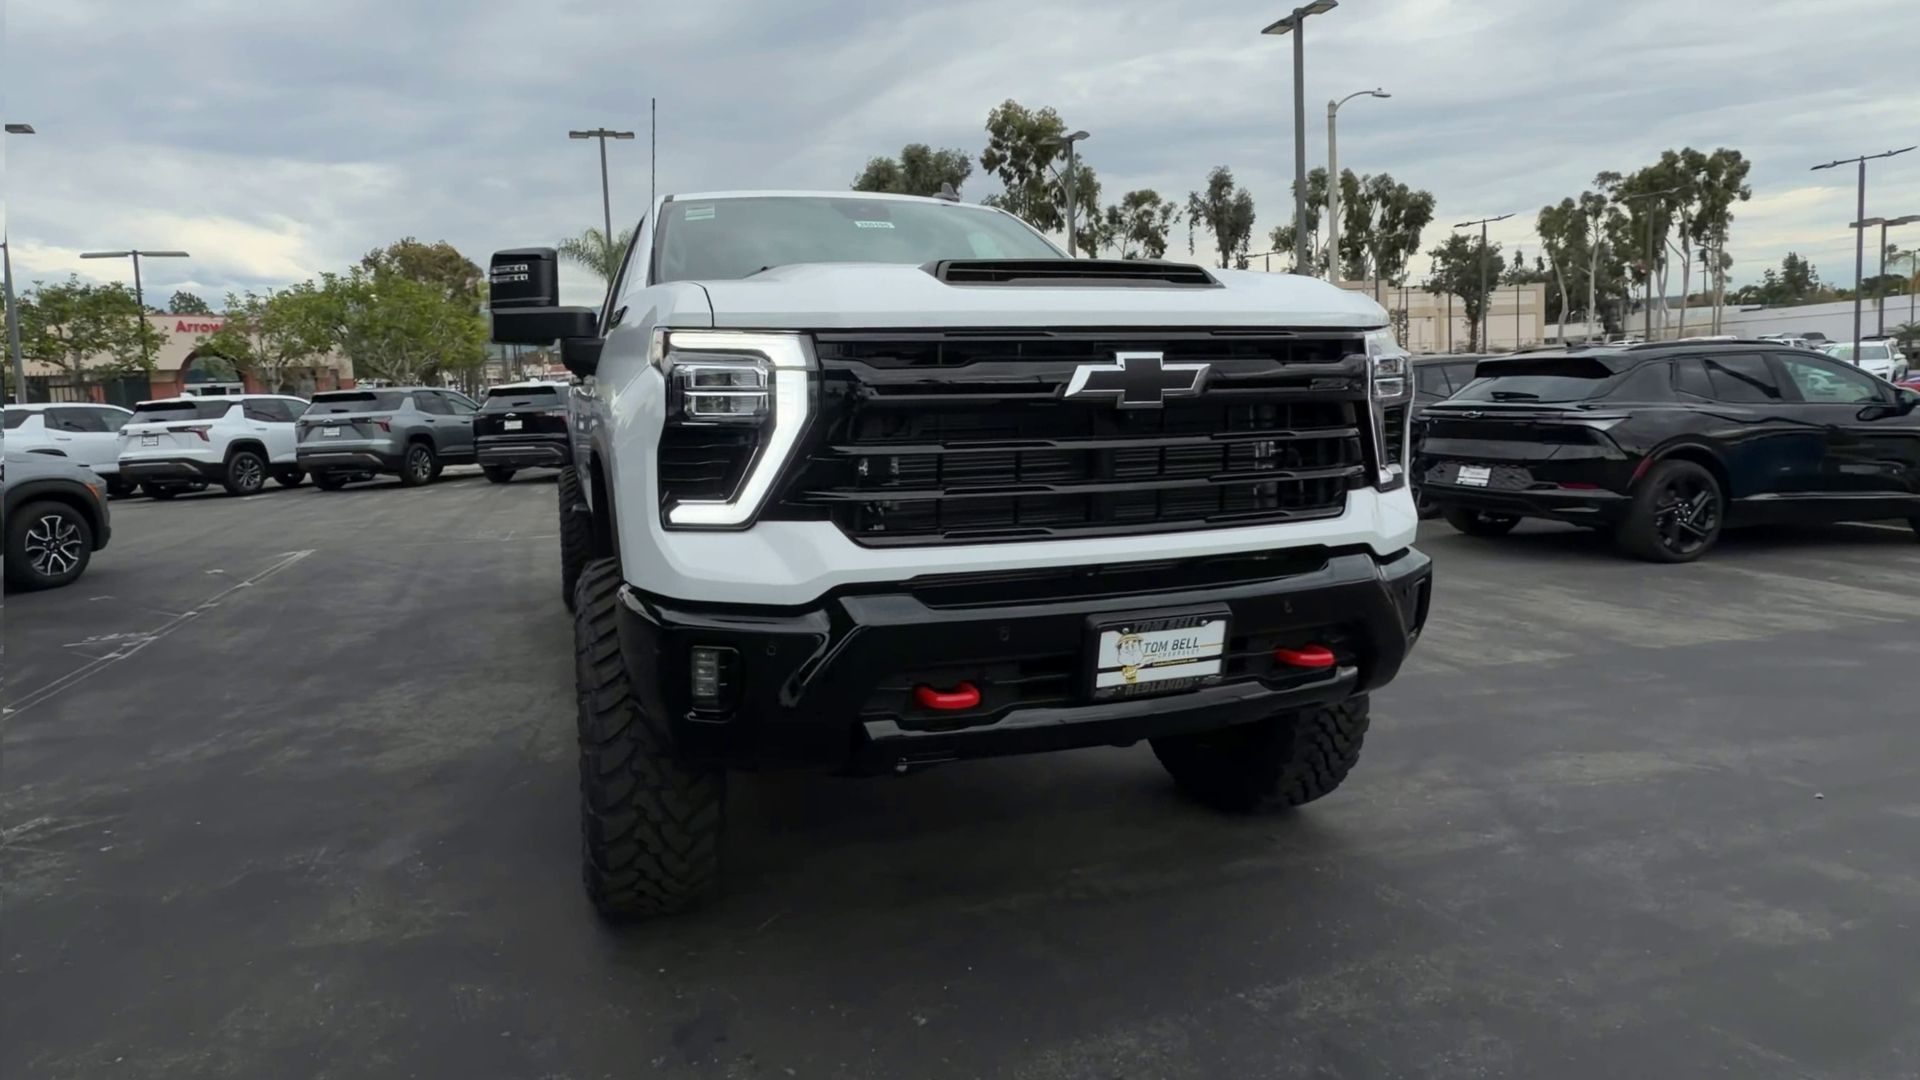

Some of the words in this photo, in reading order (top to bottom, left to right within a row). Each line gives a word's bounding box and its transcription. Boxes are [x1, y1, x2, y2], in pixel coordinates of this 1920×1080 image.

[1133, 619, 1168, 632] TOM
[1170, 616, 1198, 630] BELL
[1144, 640, 1168, 653] TOM
[1171, 637, 1199, 651] BELL
